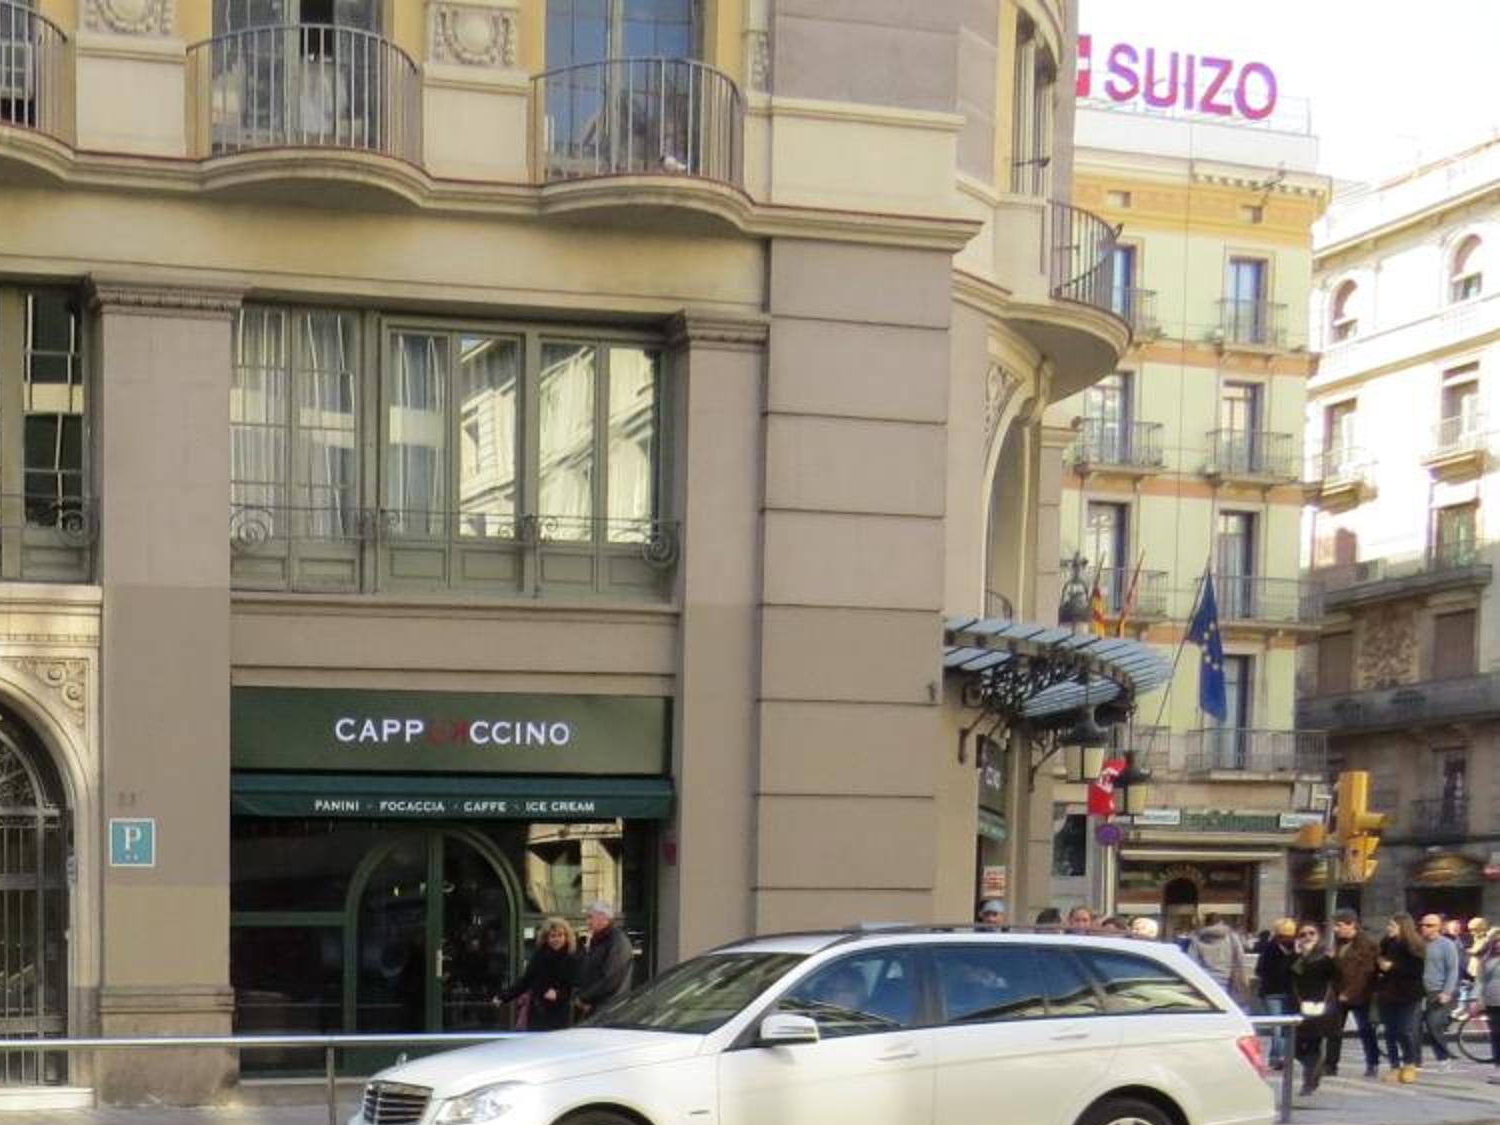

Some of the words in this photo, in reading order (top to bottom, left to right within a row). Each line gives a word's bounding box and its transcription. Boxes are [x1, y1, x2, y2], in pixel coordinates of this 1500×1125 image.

[1104, 43, 1278, 120] SUIZO
[314, 799, 360, 812] PANINI
[379, 800, 445, 813] FOCACCIA
[525, 800, 547, 812] ICE
[551, 801, 595, 813] CREAM
[123, 826, 142, 851] P
